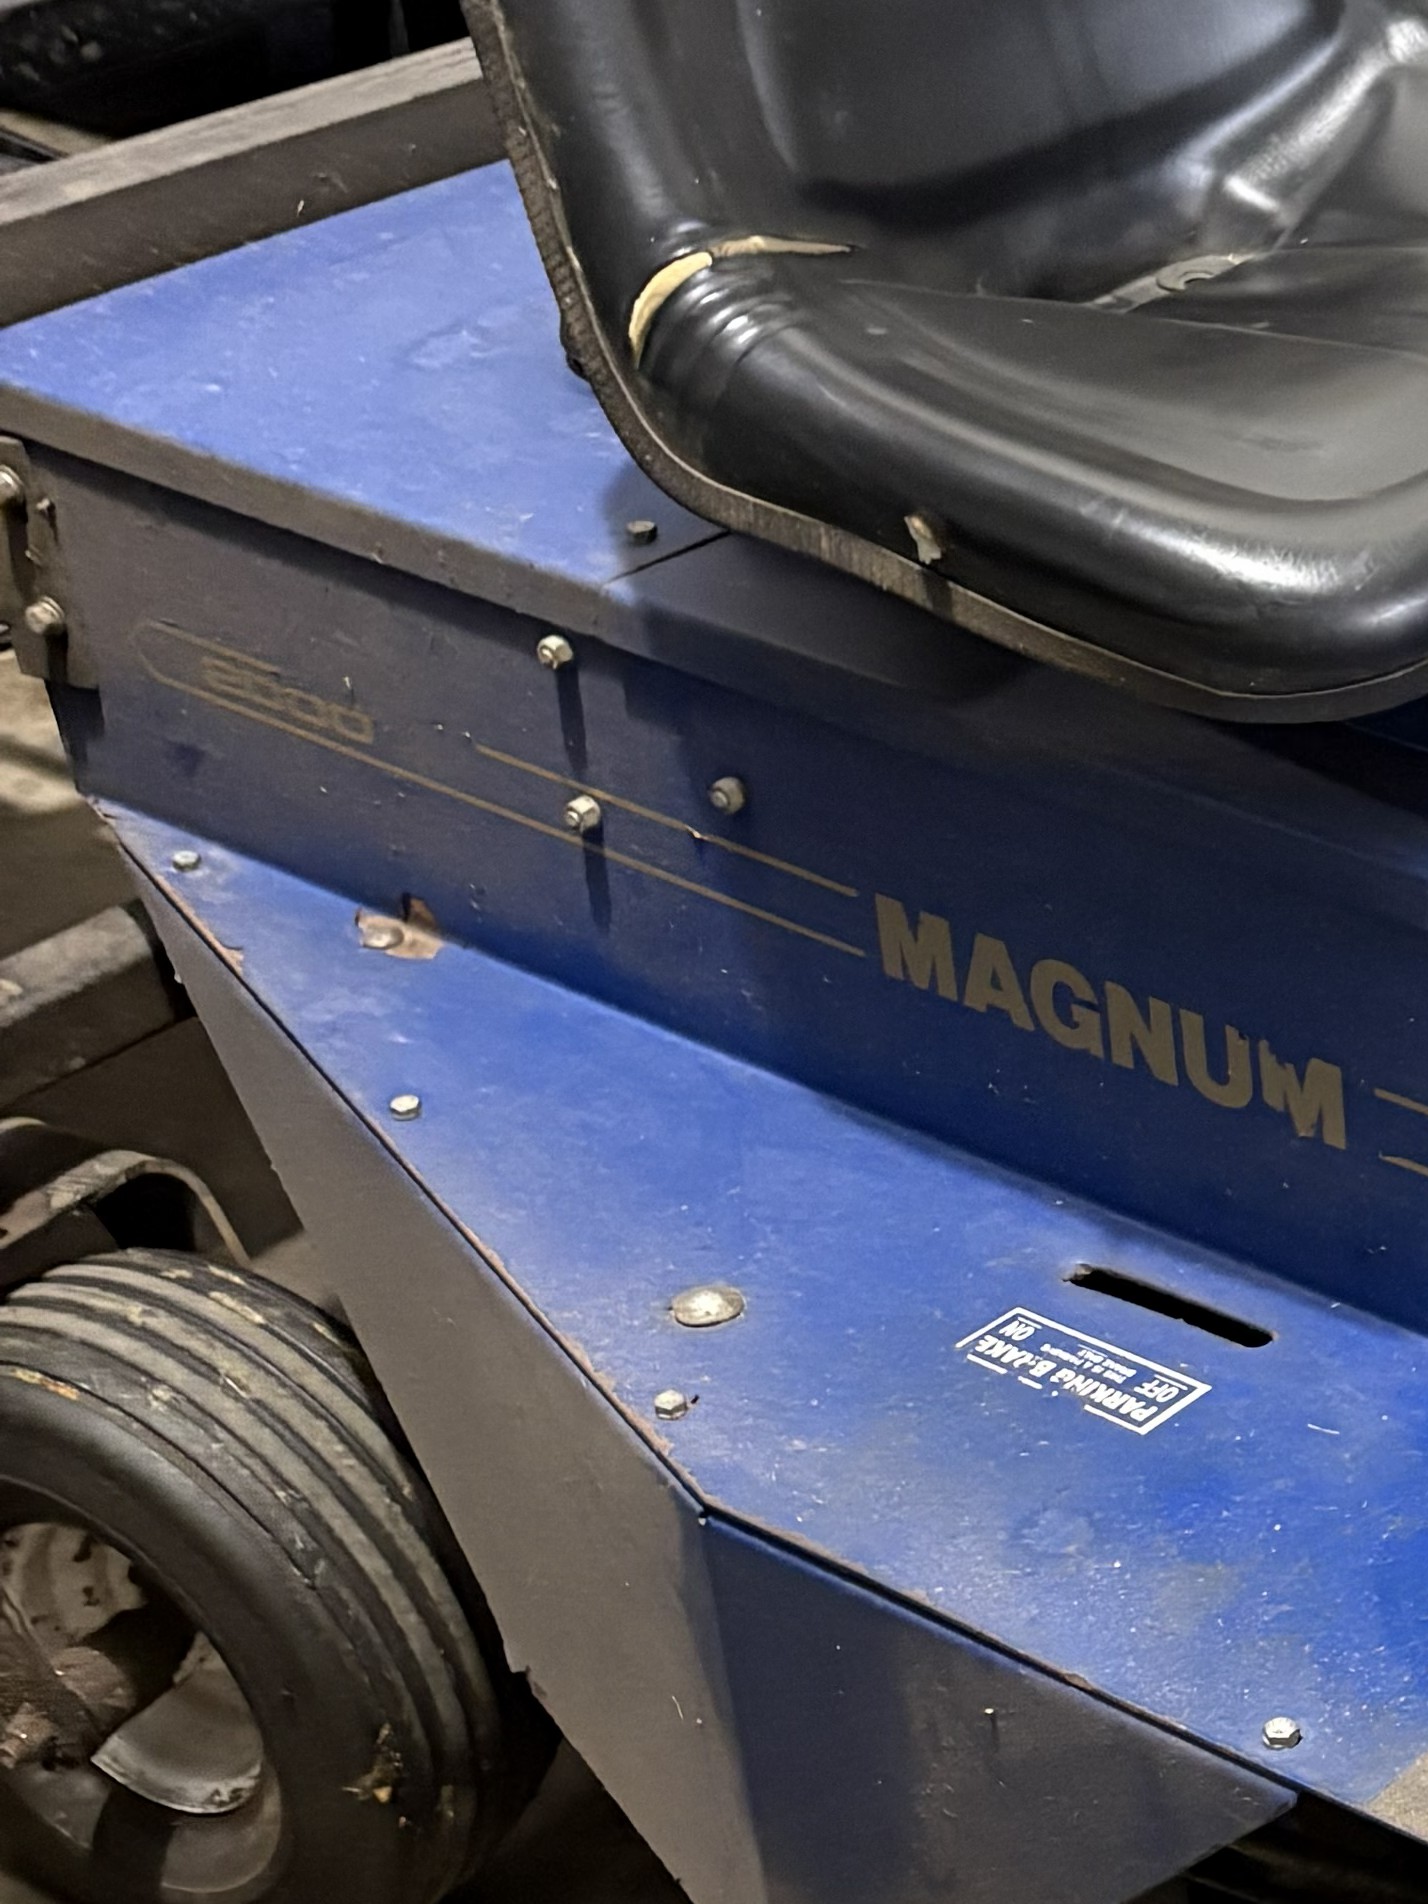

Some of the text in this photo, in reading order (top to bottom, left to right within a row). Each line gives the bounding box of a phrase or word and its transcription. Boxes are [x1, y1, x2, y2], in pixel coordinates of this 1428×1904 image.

[875, 892, 1346, 1150] MAGNUM
[999, 1320, 1034, 1341] ON
[974, 1334, 1158, 1421] PARKING BRAKE
[1134, 1378, 1179, 1403] OFF
